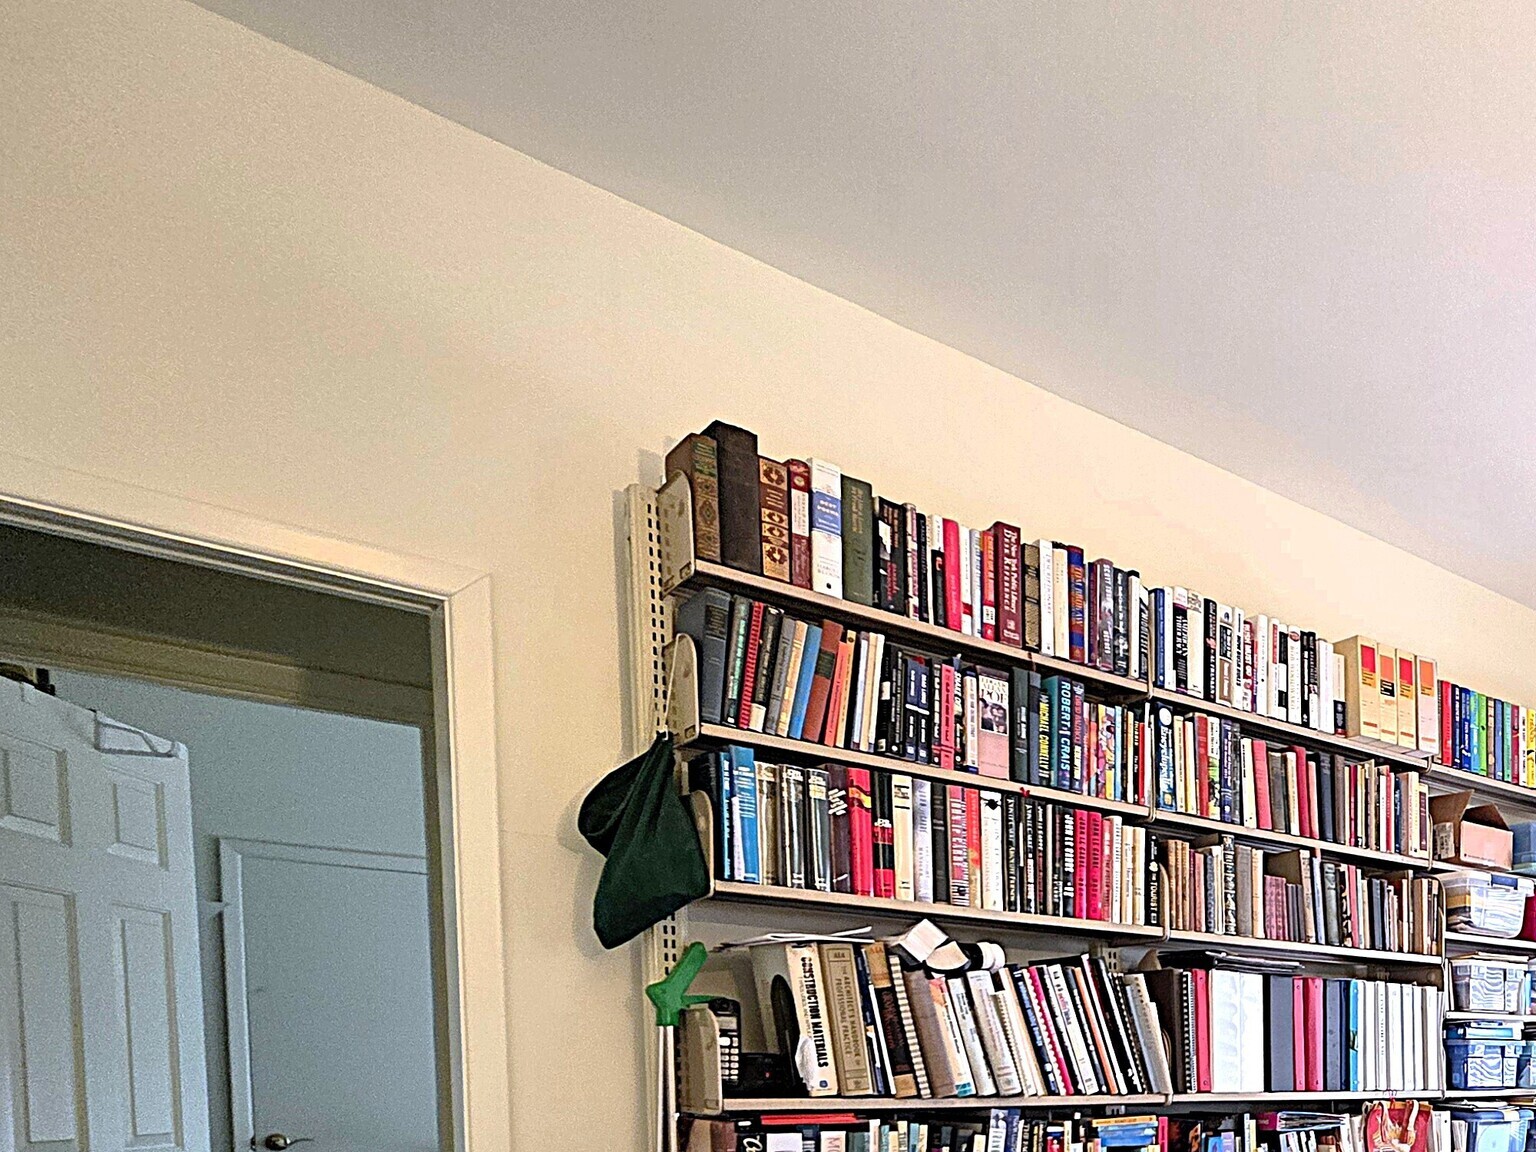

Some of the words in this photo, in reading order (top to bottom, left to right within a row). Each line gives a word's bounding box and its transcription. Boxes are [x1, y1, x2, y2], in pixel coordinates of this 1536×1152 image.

[1003, 529, 1011, 554] DESK
[1003, 557, 1011, 611] REFERENCE
[1010, 572, 1018, 589] Public
[1039, 702, 1049, 732] MICHAEL
[1061, 682, 1071, 727] ROBERT
[1039, 735, 1049, 769] CONNELLY
[1061, 738, 1071, 770] CRAIS
[1064, 815, 1074, 835] JOHN
[800, 956, 820, 1021] CONSTRUCTION
[812, 1022, 829, 1068] MATERIALS
[835, 978, 847, 1023] PROFESSIONAL
[841, 1025, 852, 1055] PRACTICE
[843, 976, 855, 1018] ARCHITECT'S
[850, 1020, 862, 1057] HANDBOOK
[898, 1132, 907, 1149] THE
